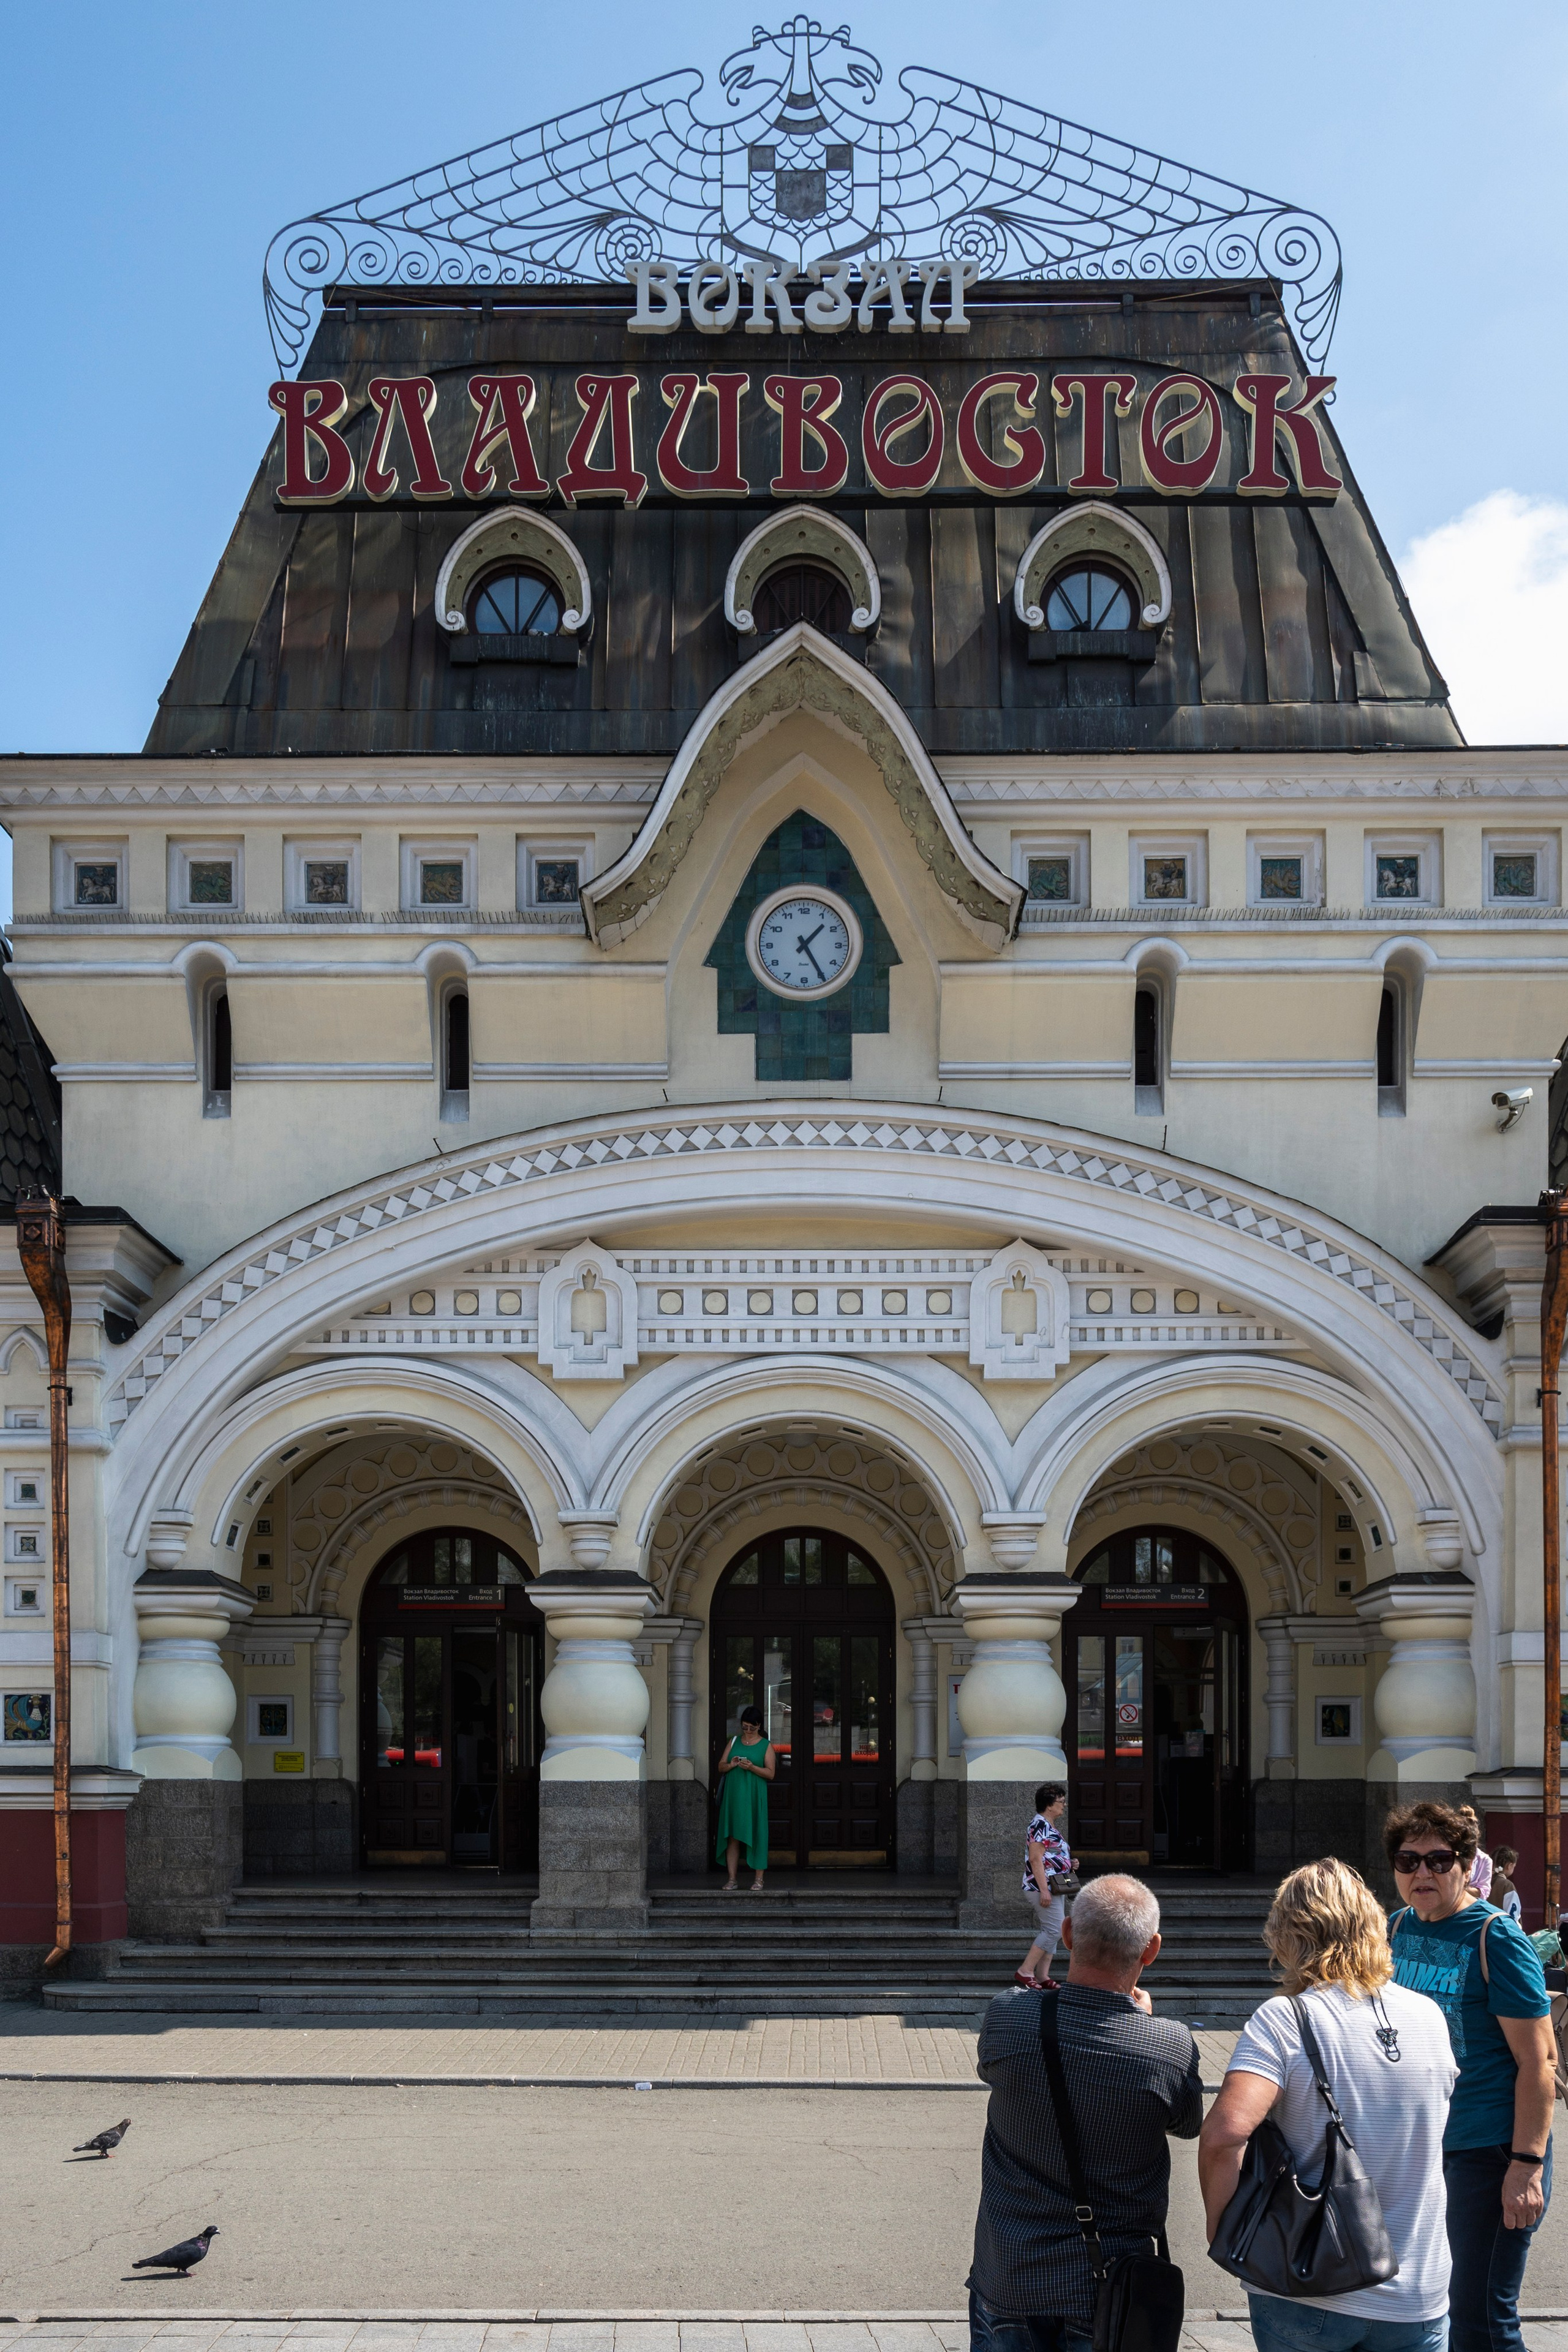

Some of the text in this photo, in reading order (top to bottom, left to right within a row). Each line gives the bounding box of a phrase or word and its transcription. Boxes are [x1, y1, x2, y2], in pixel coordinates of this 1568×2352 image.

[624, 260, 981, 334] ВОКЗАЛ
[268, 371, 1343, 509] ВЛАДИВОСТОК
[496, 1589, 501, 1600] 1
[1197, 1588, 1205, 1599] 2
[1392, 1958, 1459, 1994] MMER
